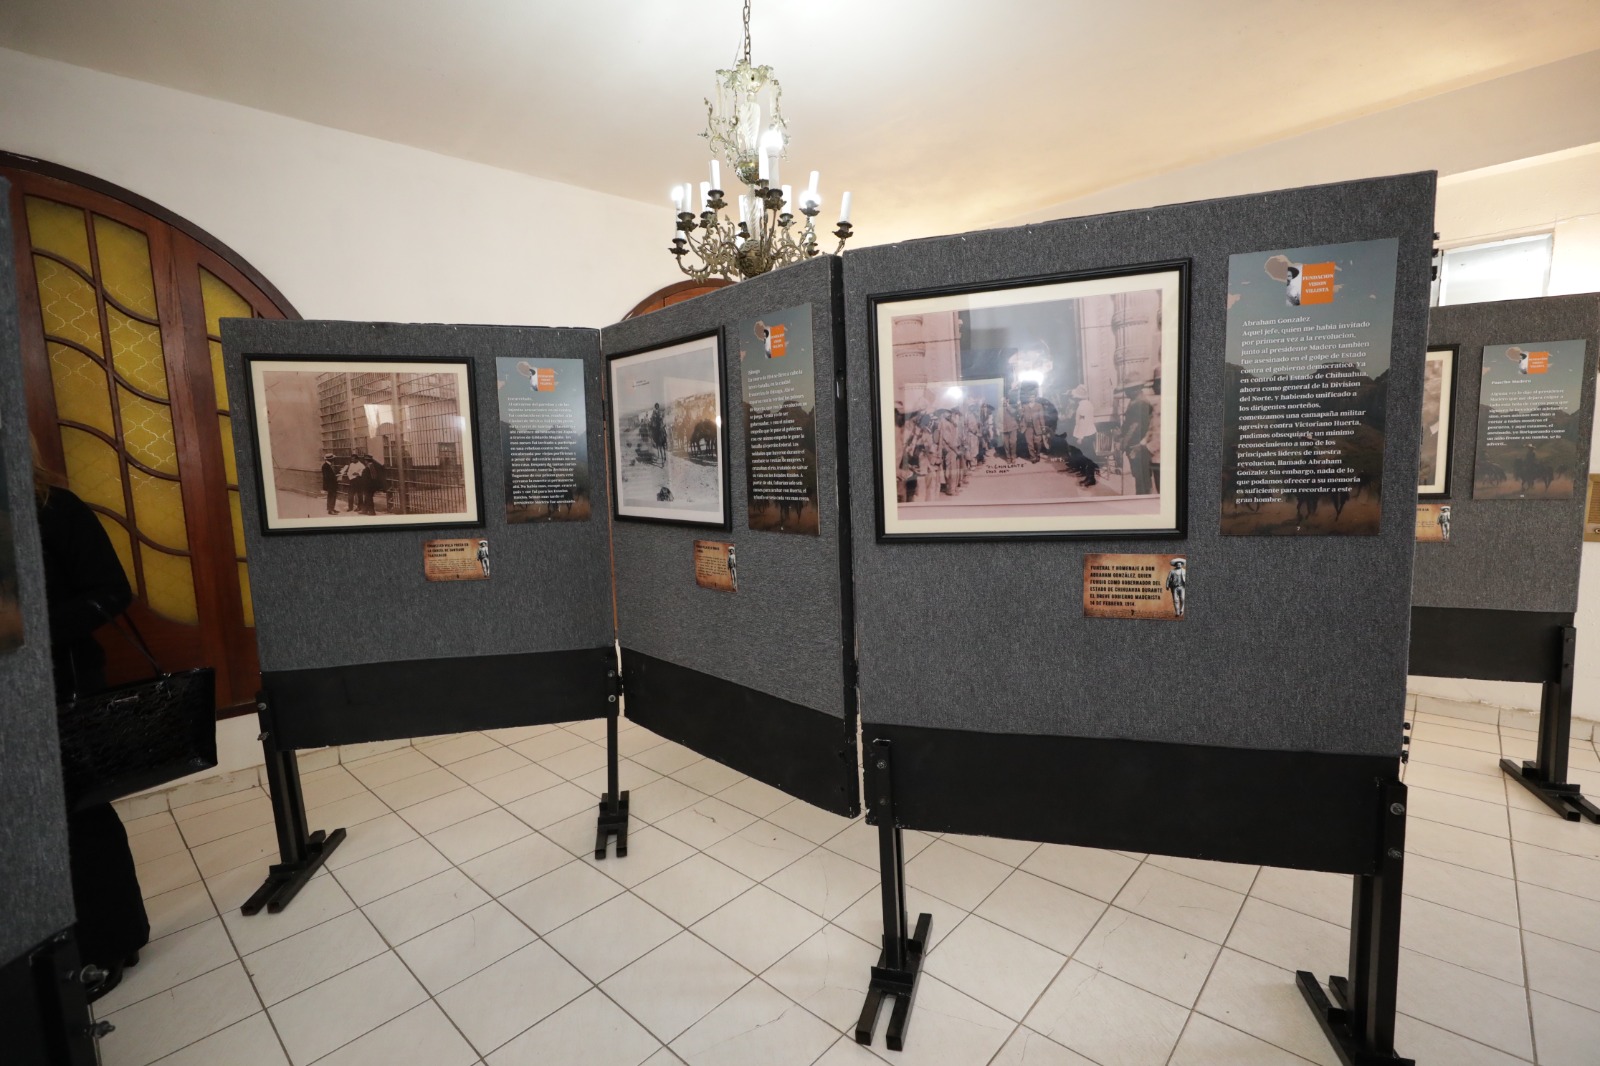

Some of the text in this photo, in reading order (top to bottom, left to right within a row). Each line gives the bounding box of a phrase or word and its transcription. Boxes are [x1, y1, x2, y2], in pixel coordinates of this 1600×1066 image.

[1243, 316, 1310, 326] Abraham Gonzalez
[1243, 329, 1263, 338] Aquel
[1281, 326, 1302, 335] quien
[1339, 321, 1371, 330] invitado
[1256, 337, 1285, 347] primera
[1242, 348, 1261, 357] junto
[1270, 345, 1308, 355] presidente
[1254, 355, 1290, 364] asesinado
[1309, 353, 1330, 362] golpe
[1273, 364, 1306, 374] gobierno
[1283, 383, 1310, 393] general
[1251, 404, 1287, 413] dirigentes
[1239, 423, 1269, 432] agresiva
[1240, 432, 1271, 441] pudimos
[1272, 430, 1314, 440] obsequiarle
[1238, 450, 1277, 459] principales
[1251, 478, 1283, 486] podamos
